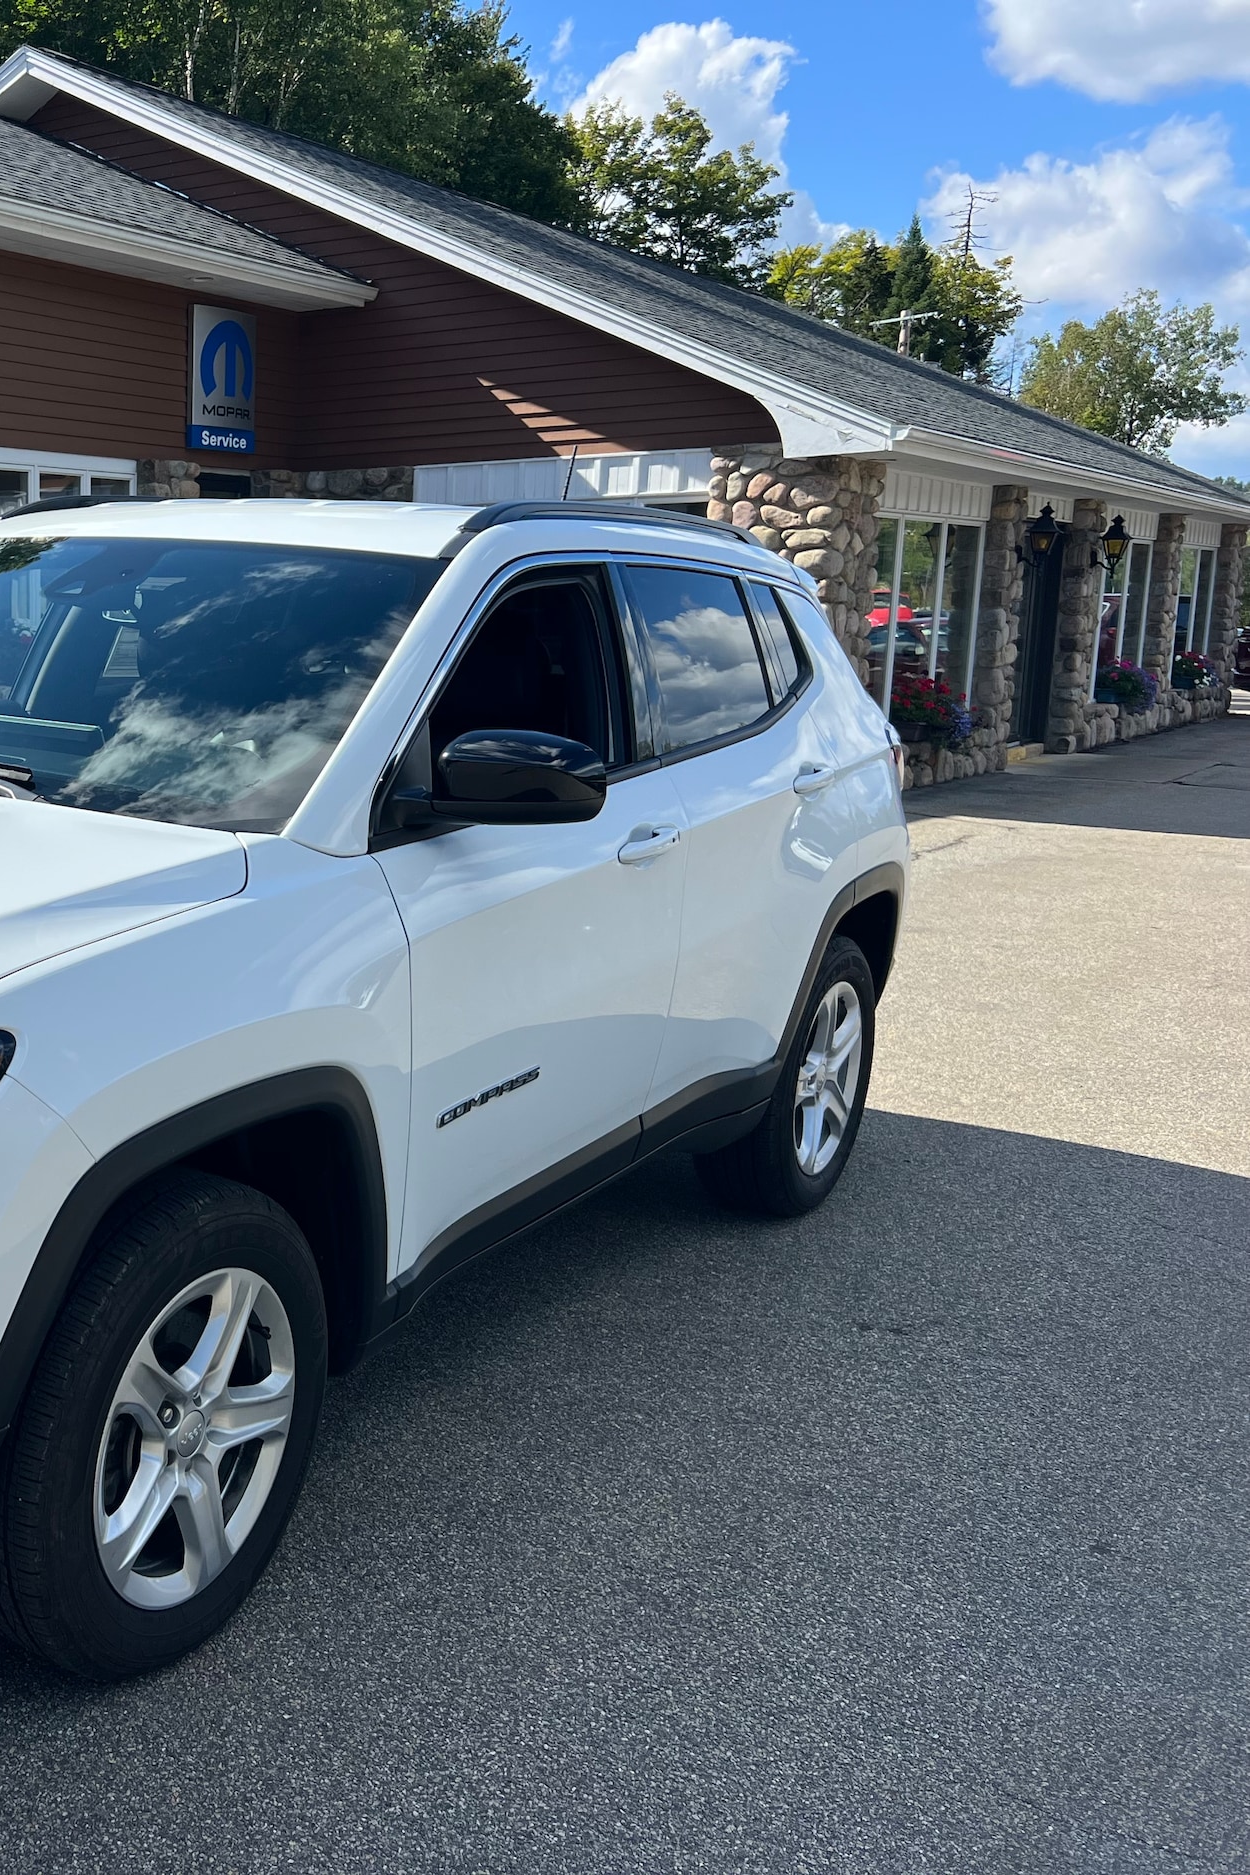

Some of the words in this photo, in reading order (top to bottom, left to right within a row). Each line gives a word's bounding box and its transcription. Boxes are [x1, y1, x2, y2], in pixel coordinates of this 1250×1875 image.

[202, 403, 250, 420] MOPAR
[201, 430, 247, 449] Service
[435, 1064, 541, 1128] COMPASS
